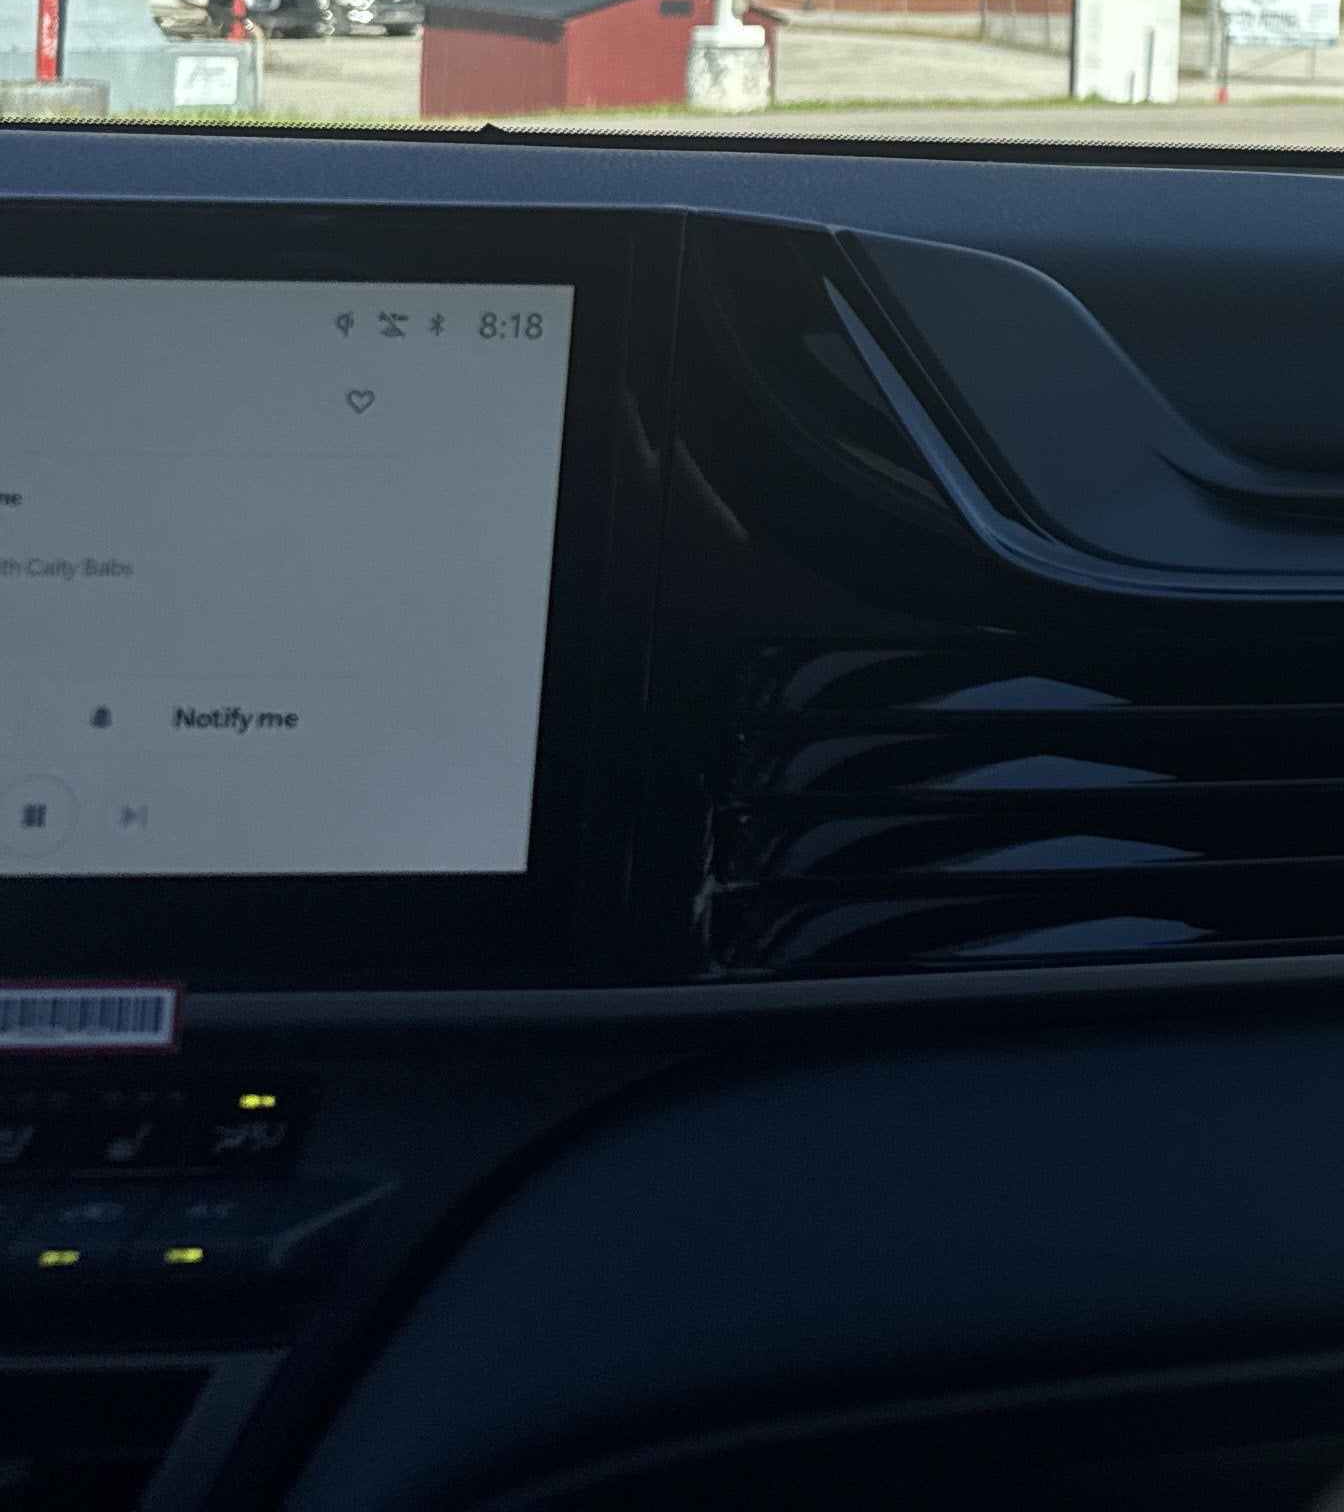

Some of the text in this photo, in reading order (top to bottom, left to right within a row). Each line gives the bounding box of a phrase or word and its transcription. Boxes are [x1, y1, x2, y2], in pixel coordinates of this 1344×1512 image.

[478, 313, 544, 341] 8:18
[174, 706, 300, 736] Notify me
